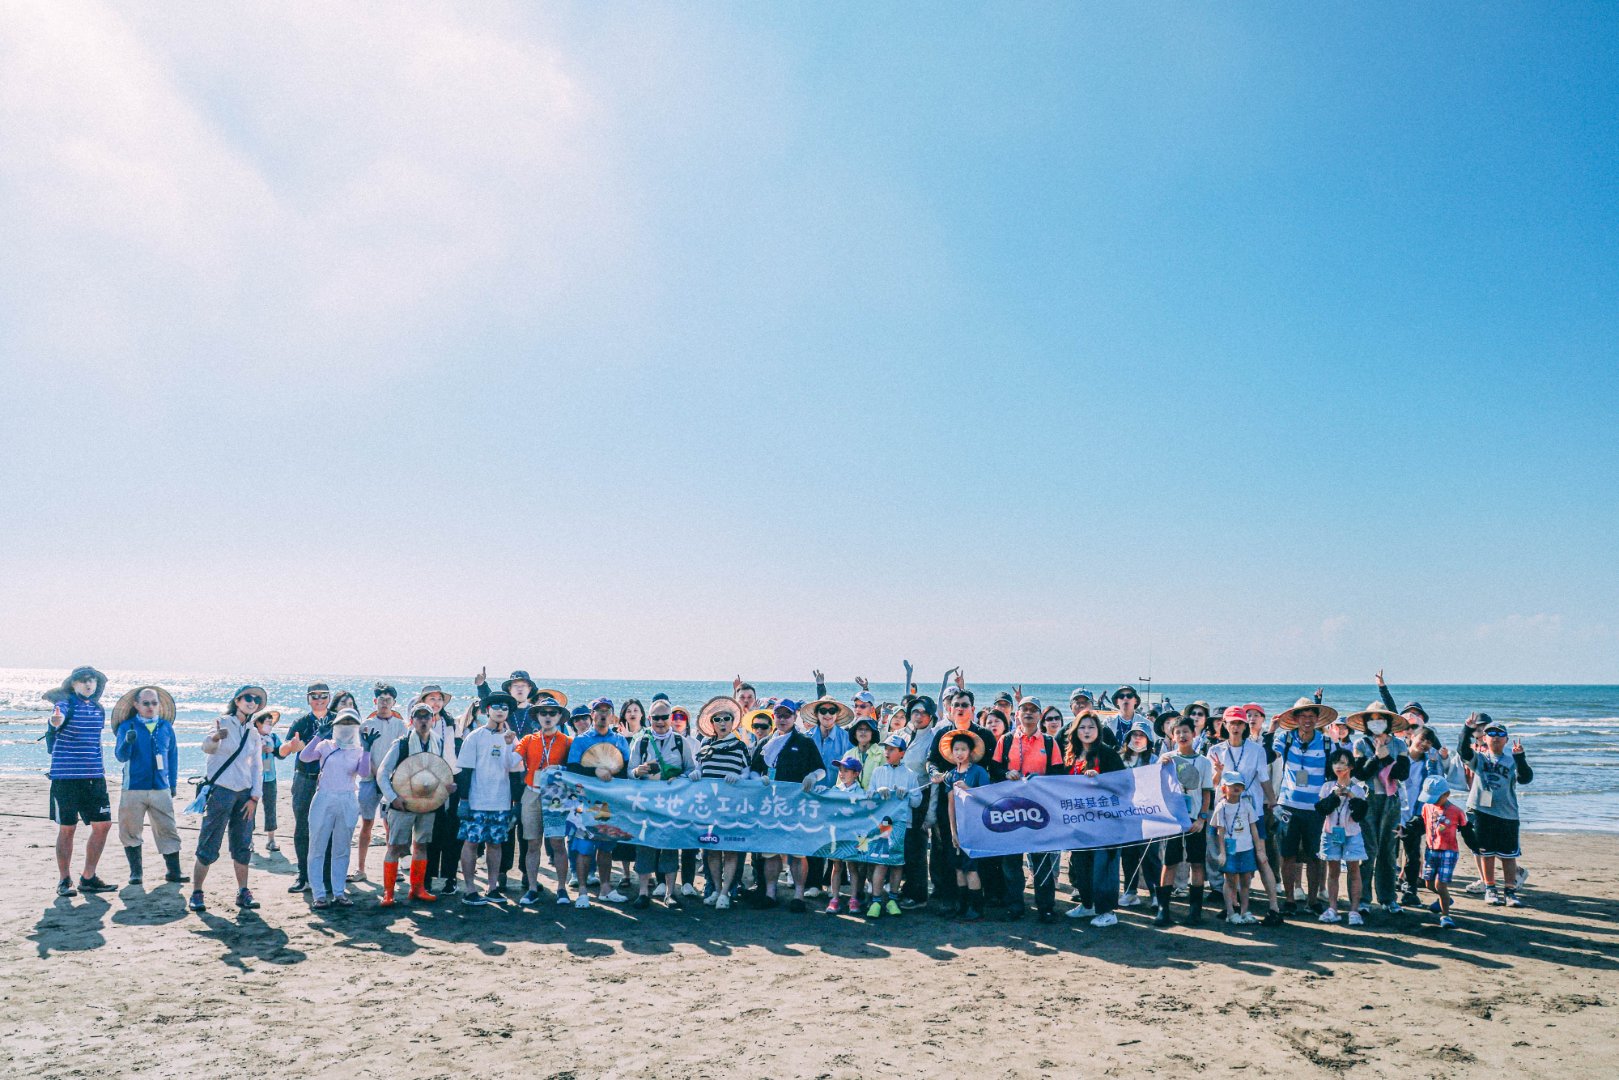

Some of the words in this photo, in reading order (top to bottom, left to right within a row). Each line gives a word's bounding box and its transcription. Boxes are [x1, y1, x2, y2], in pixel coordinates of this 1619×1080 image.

[625, 792, 821, 819] 大地志工小旅行
[1060, 795, 1120, 811] 明基基金會
[990, 807, 1043, 825] BenQ
[1063, 811, 1095, 825] BenQ
[1098, 804, 1162, 820] Foundation
